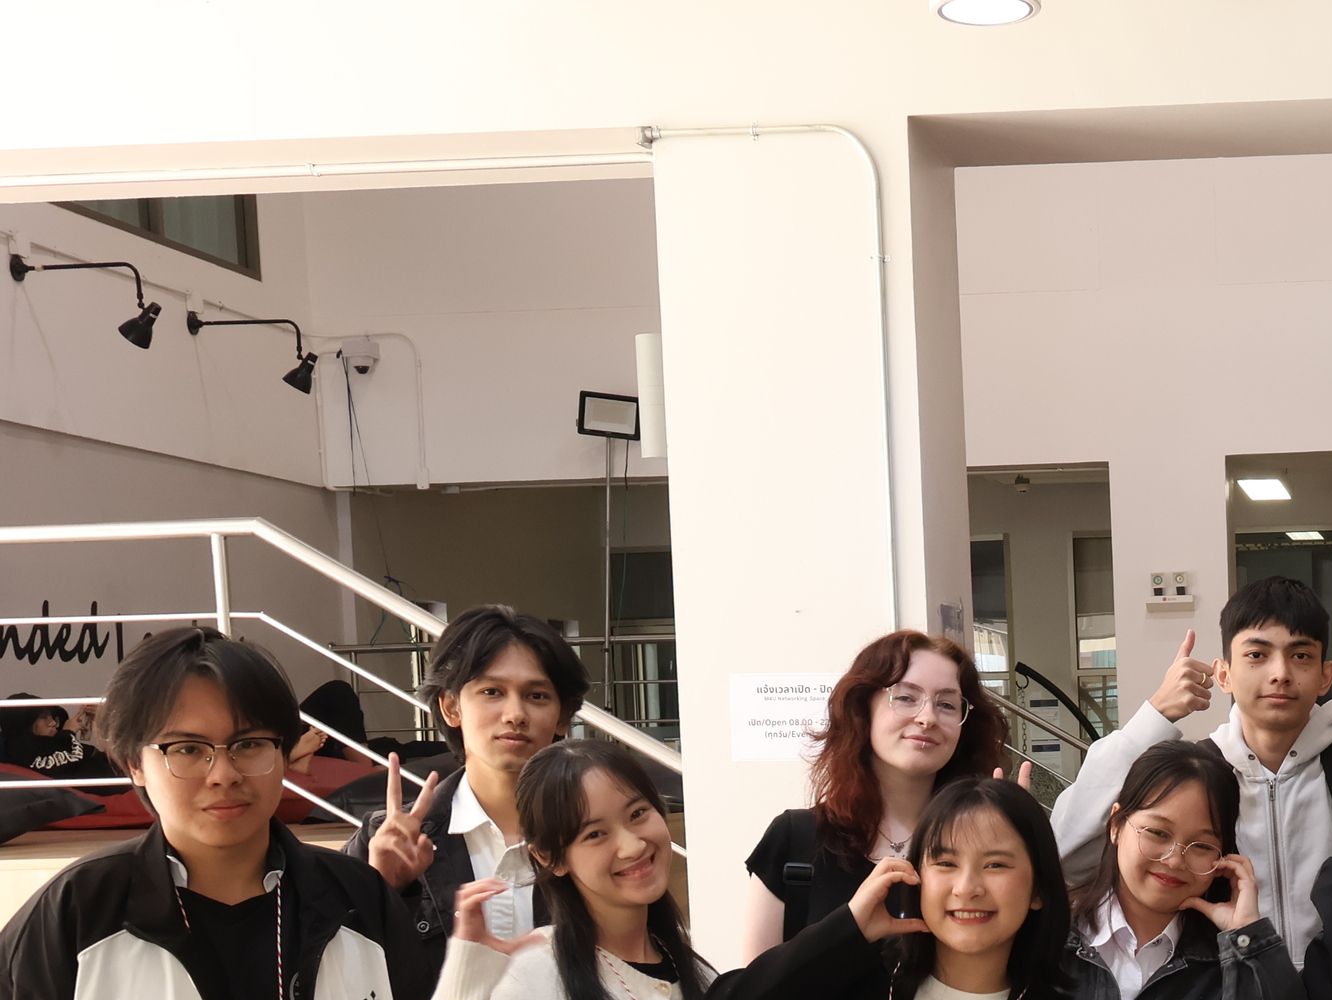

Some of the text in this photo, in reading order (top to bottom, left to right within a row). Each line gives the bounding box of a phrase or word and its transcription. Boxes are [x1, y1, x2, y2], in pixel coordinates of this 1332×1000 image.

[756, 684, 811, 694] แจ้งเวลาเปิด
